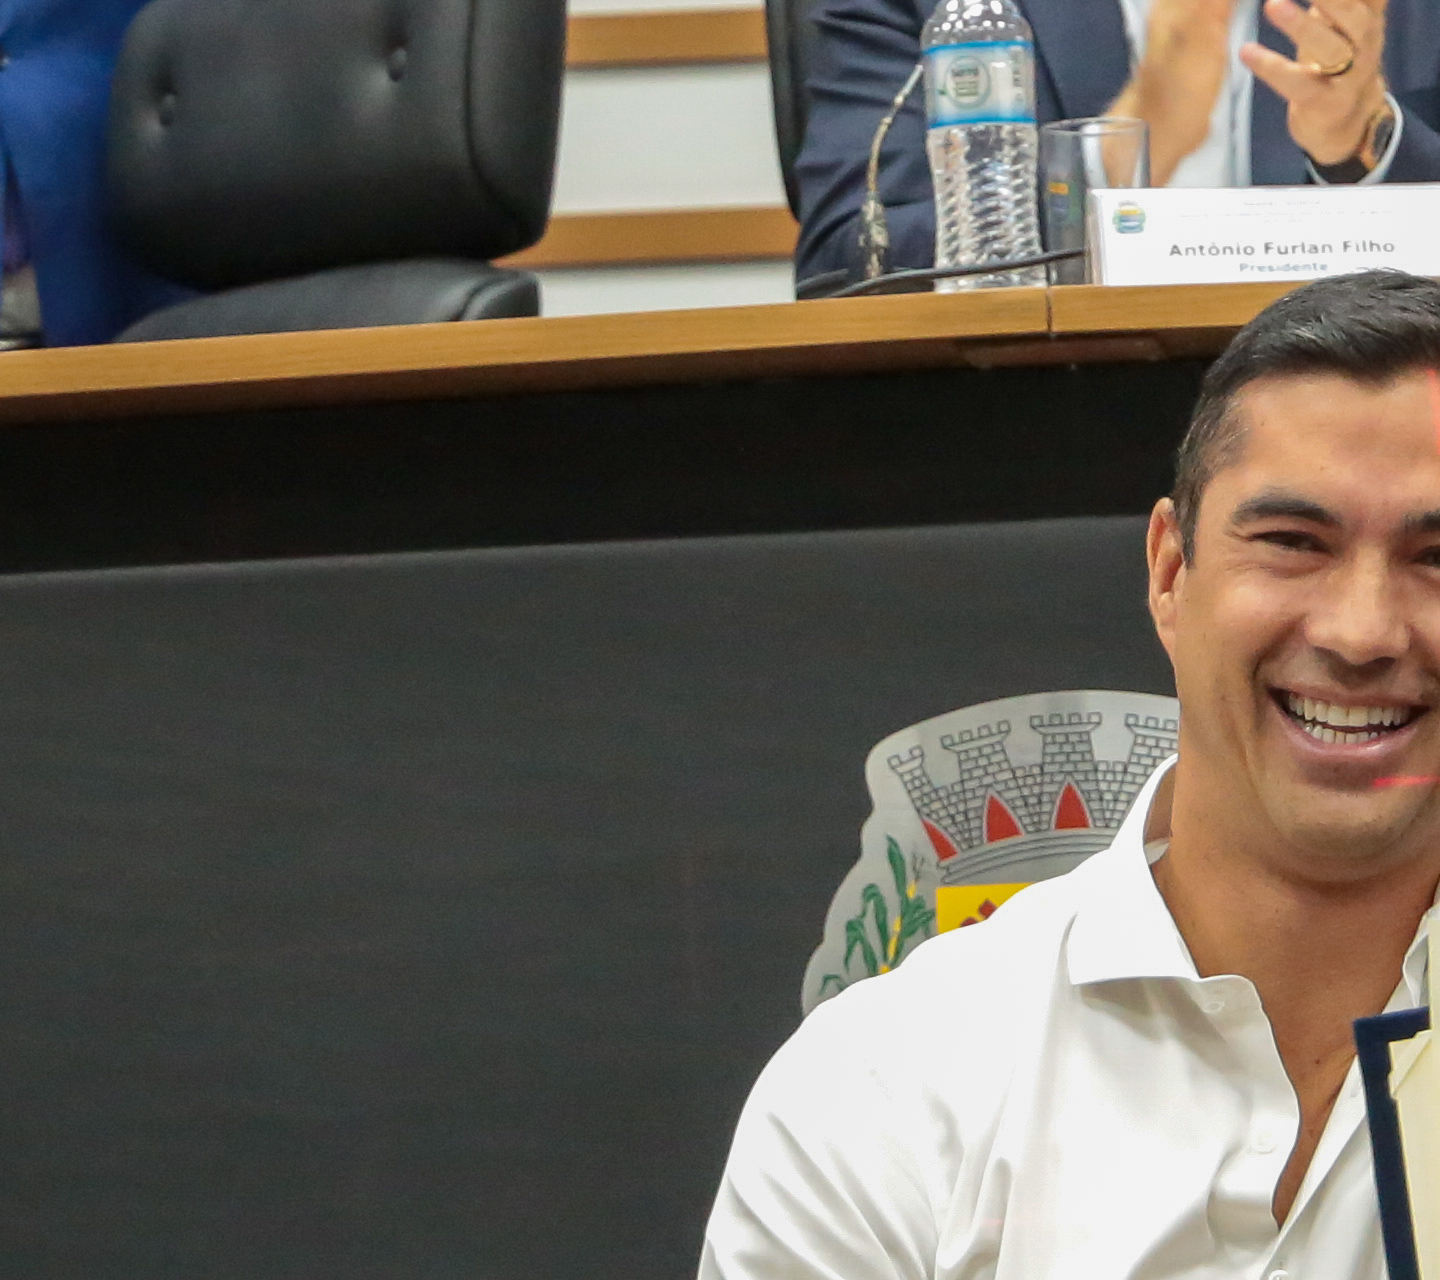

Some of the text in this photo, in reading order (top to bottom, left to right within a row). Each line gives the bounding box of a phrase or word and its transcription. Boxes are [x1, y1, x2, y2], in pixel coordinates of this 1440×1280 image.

[1264, 239, 1334, 256] Furlan
[1342, 239, 1396, 255] Filho
[1239, 261, 1328, 274] Presidente
